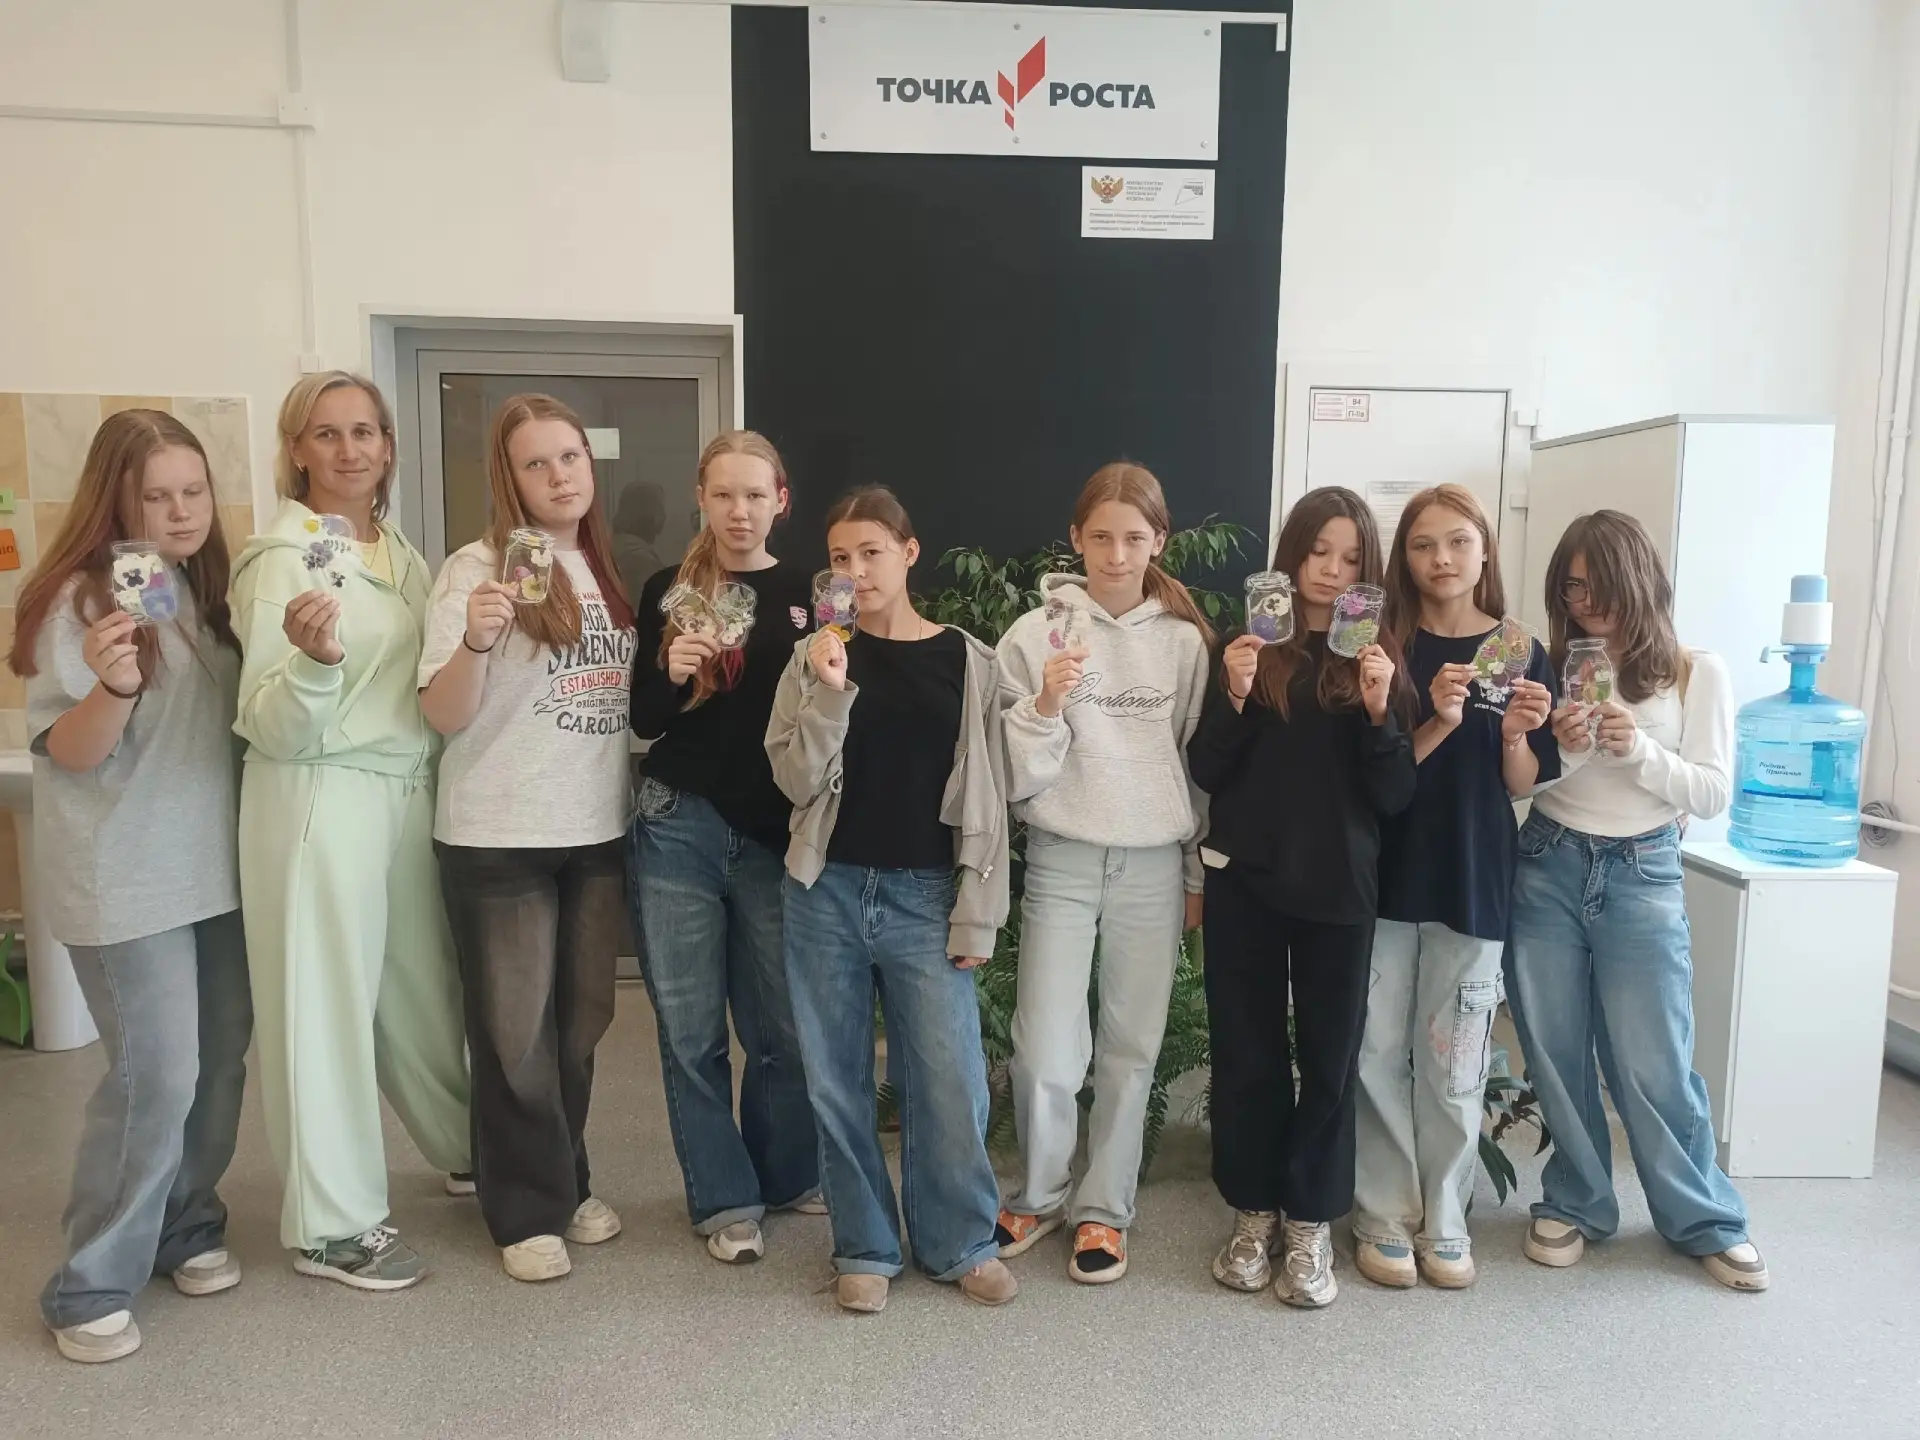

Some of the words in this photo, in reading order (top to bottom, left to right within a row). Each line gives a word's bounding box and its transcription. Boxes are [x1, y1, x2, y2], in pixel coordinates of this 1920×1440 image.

[876, 77, 992, 105] ТОЧКА
[1050, 82, 1156, 109] РОСТА
[560, 670, 621, 695] ESTABLISHED
